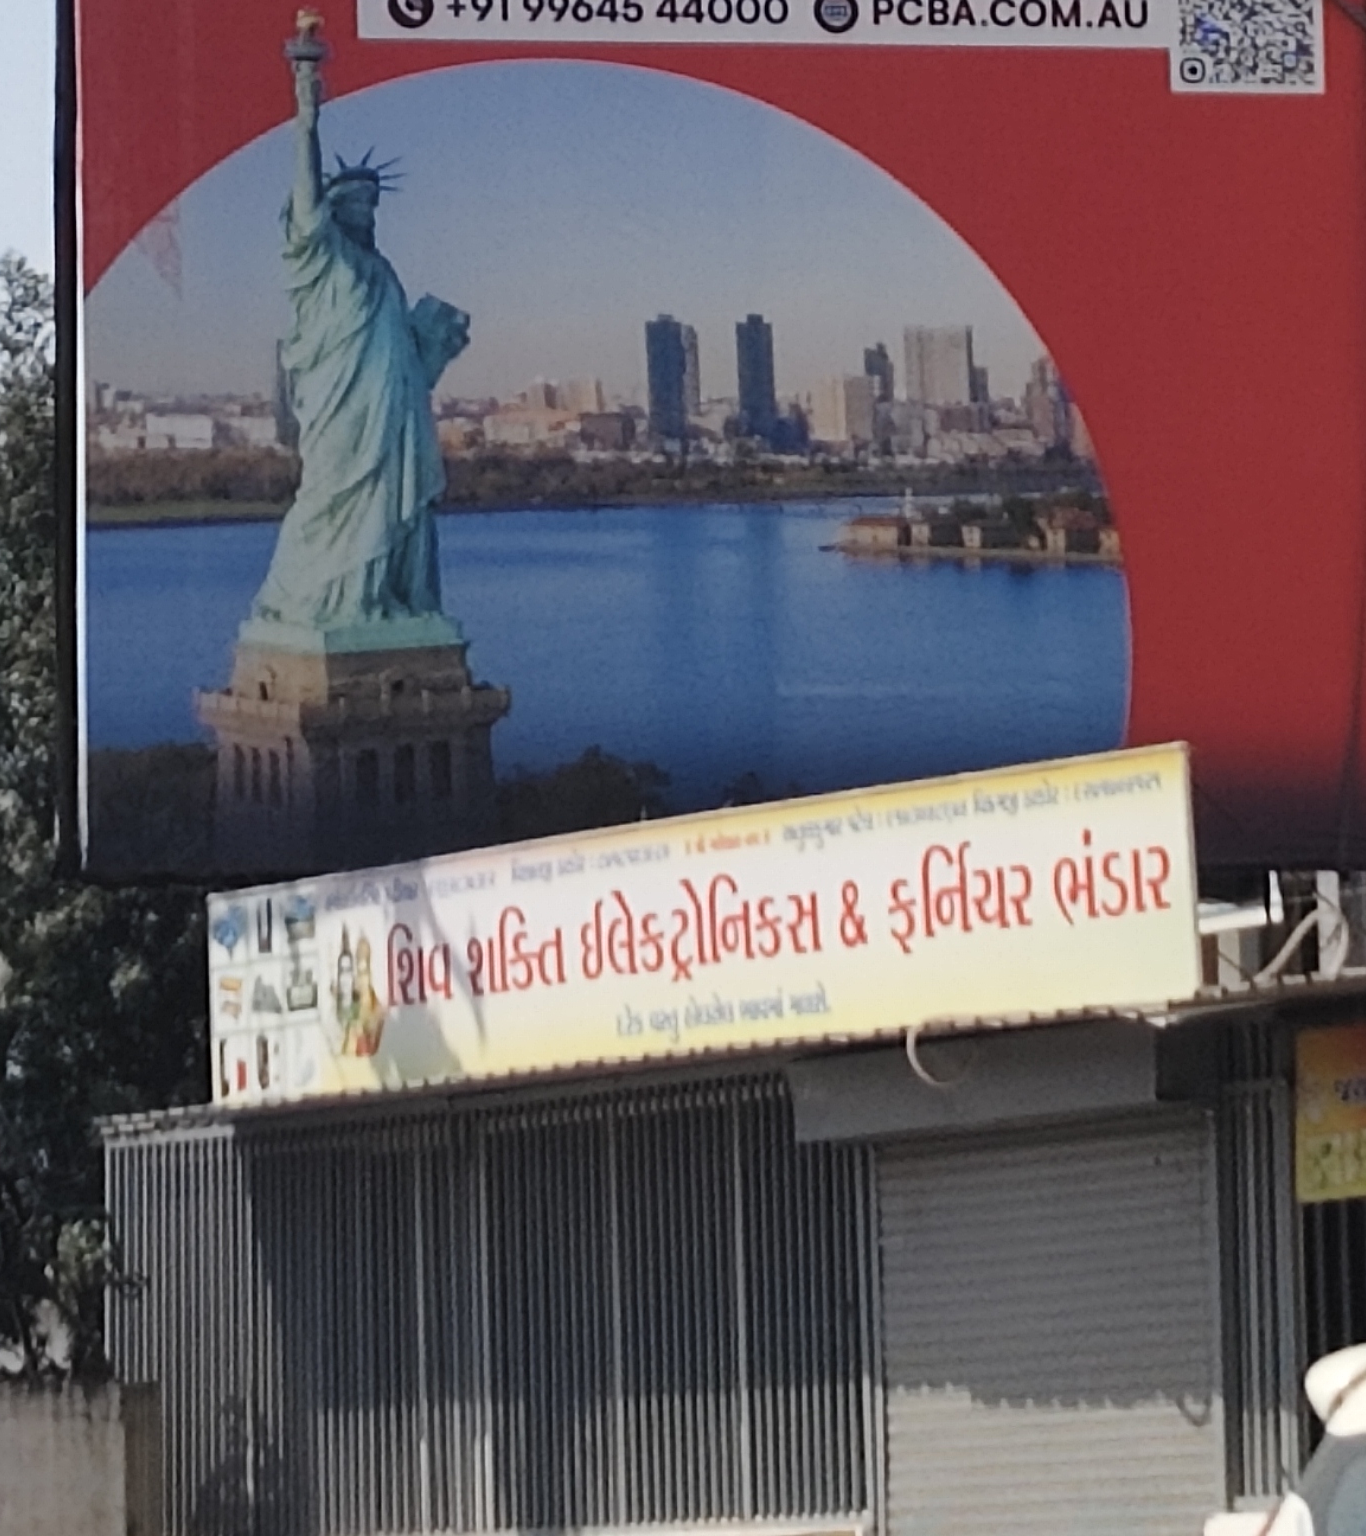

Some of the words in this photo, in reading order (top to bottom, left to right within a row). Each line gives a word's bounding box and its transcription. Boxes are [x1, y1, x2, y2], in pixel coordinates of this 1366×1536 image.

[387, 922, 453, 1007] શિવ
[839, 879, 869, 948] &
[887, 840, 1034, 954] ફર્નિચર
[1053, 828, 1171, 927] ભંડાર
